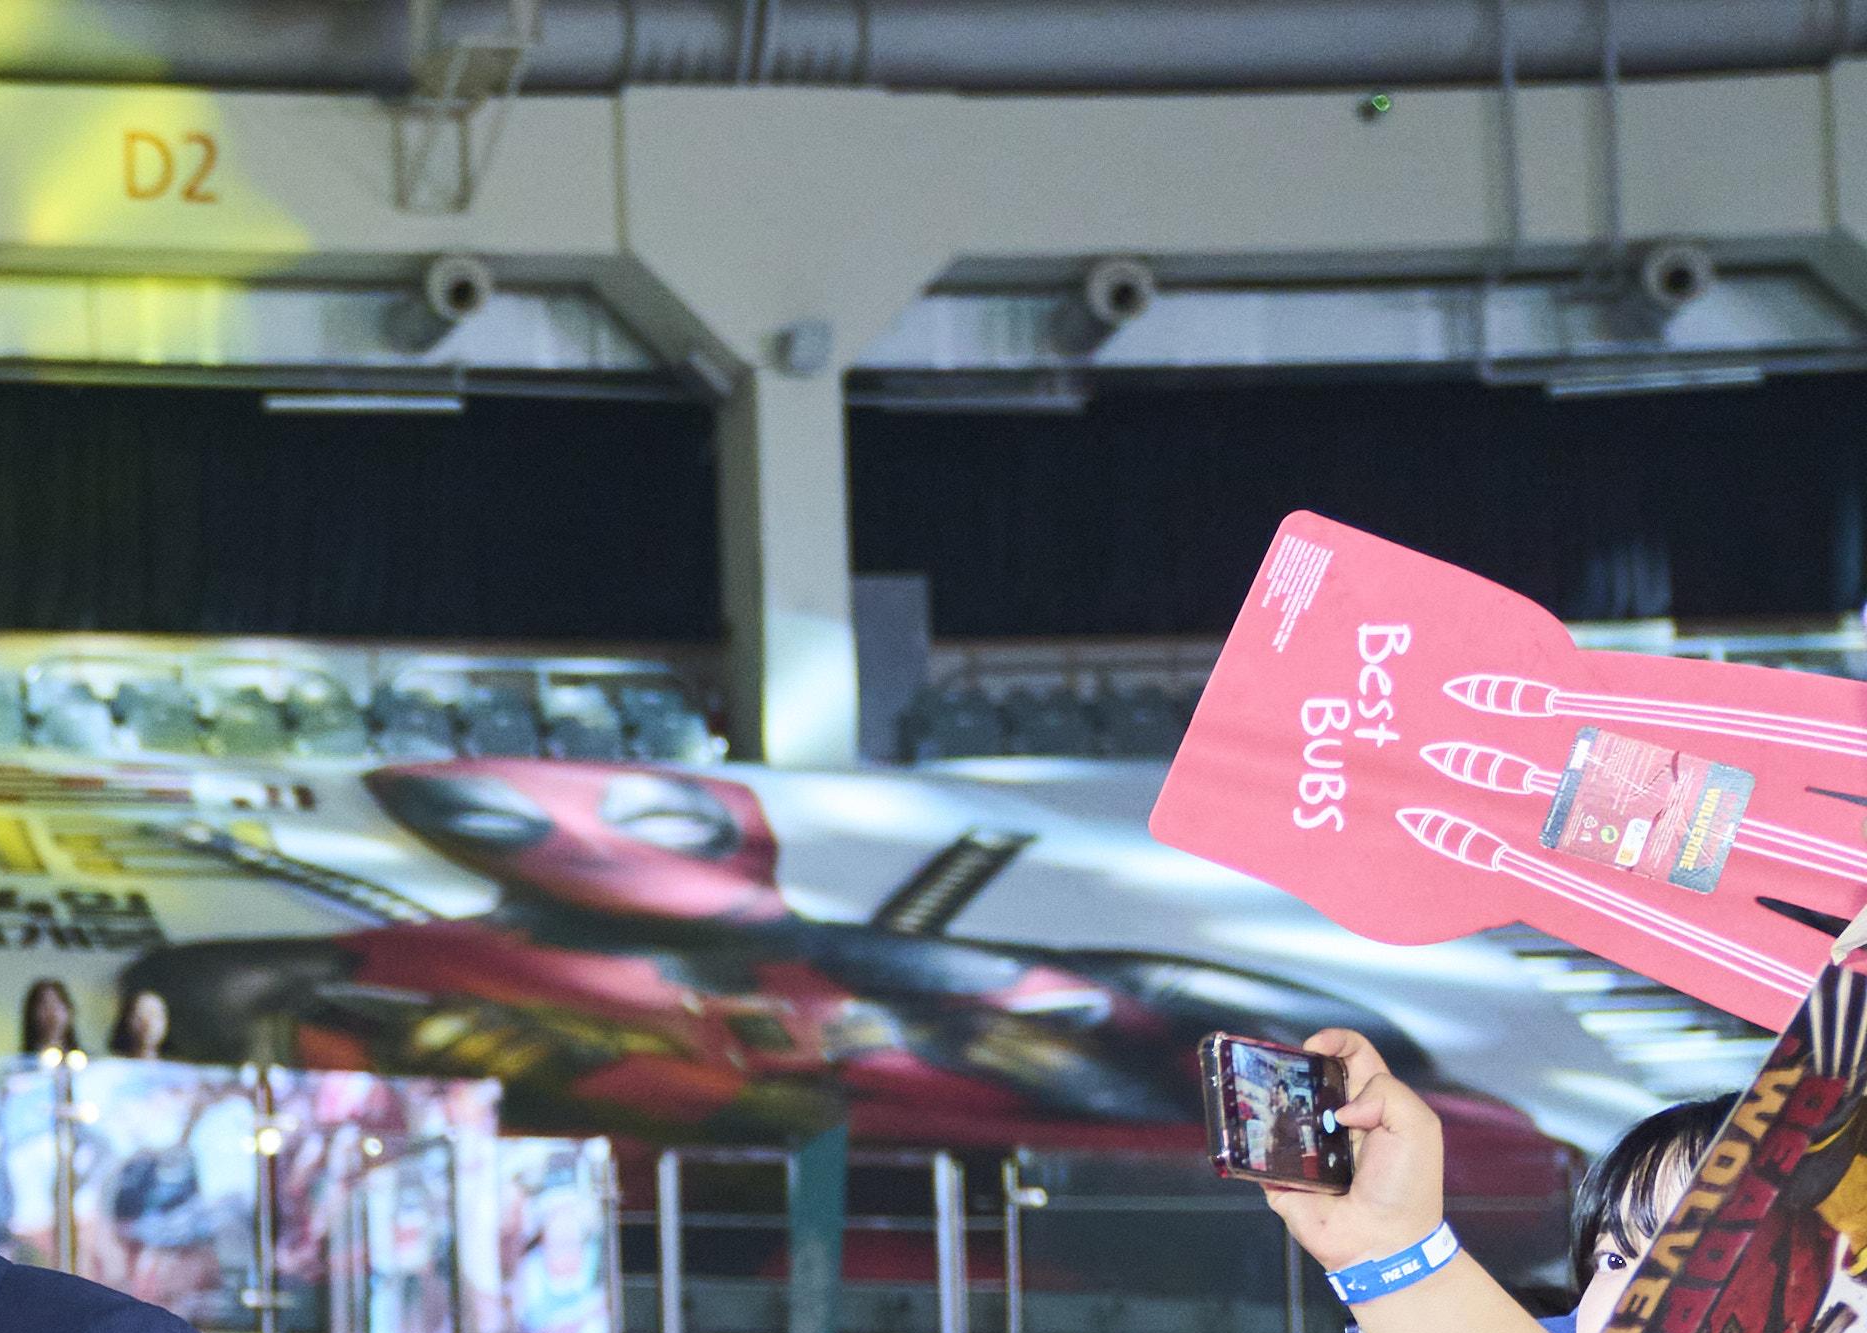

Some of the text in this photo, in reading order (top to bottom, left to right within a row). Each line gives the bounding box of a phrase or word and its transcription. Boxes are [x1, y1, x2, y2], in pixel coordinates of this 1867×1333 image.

[123, 131, 222, 202] D2
[1356, 623, 1412, 749] Best
[1292, 698, 1353, 833] BUBS
[1679, 787, 1723, 872] WOLVERINE
